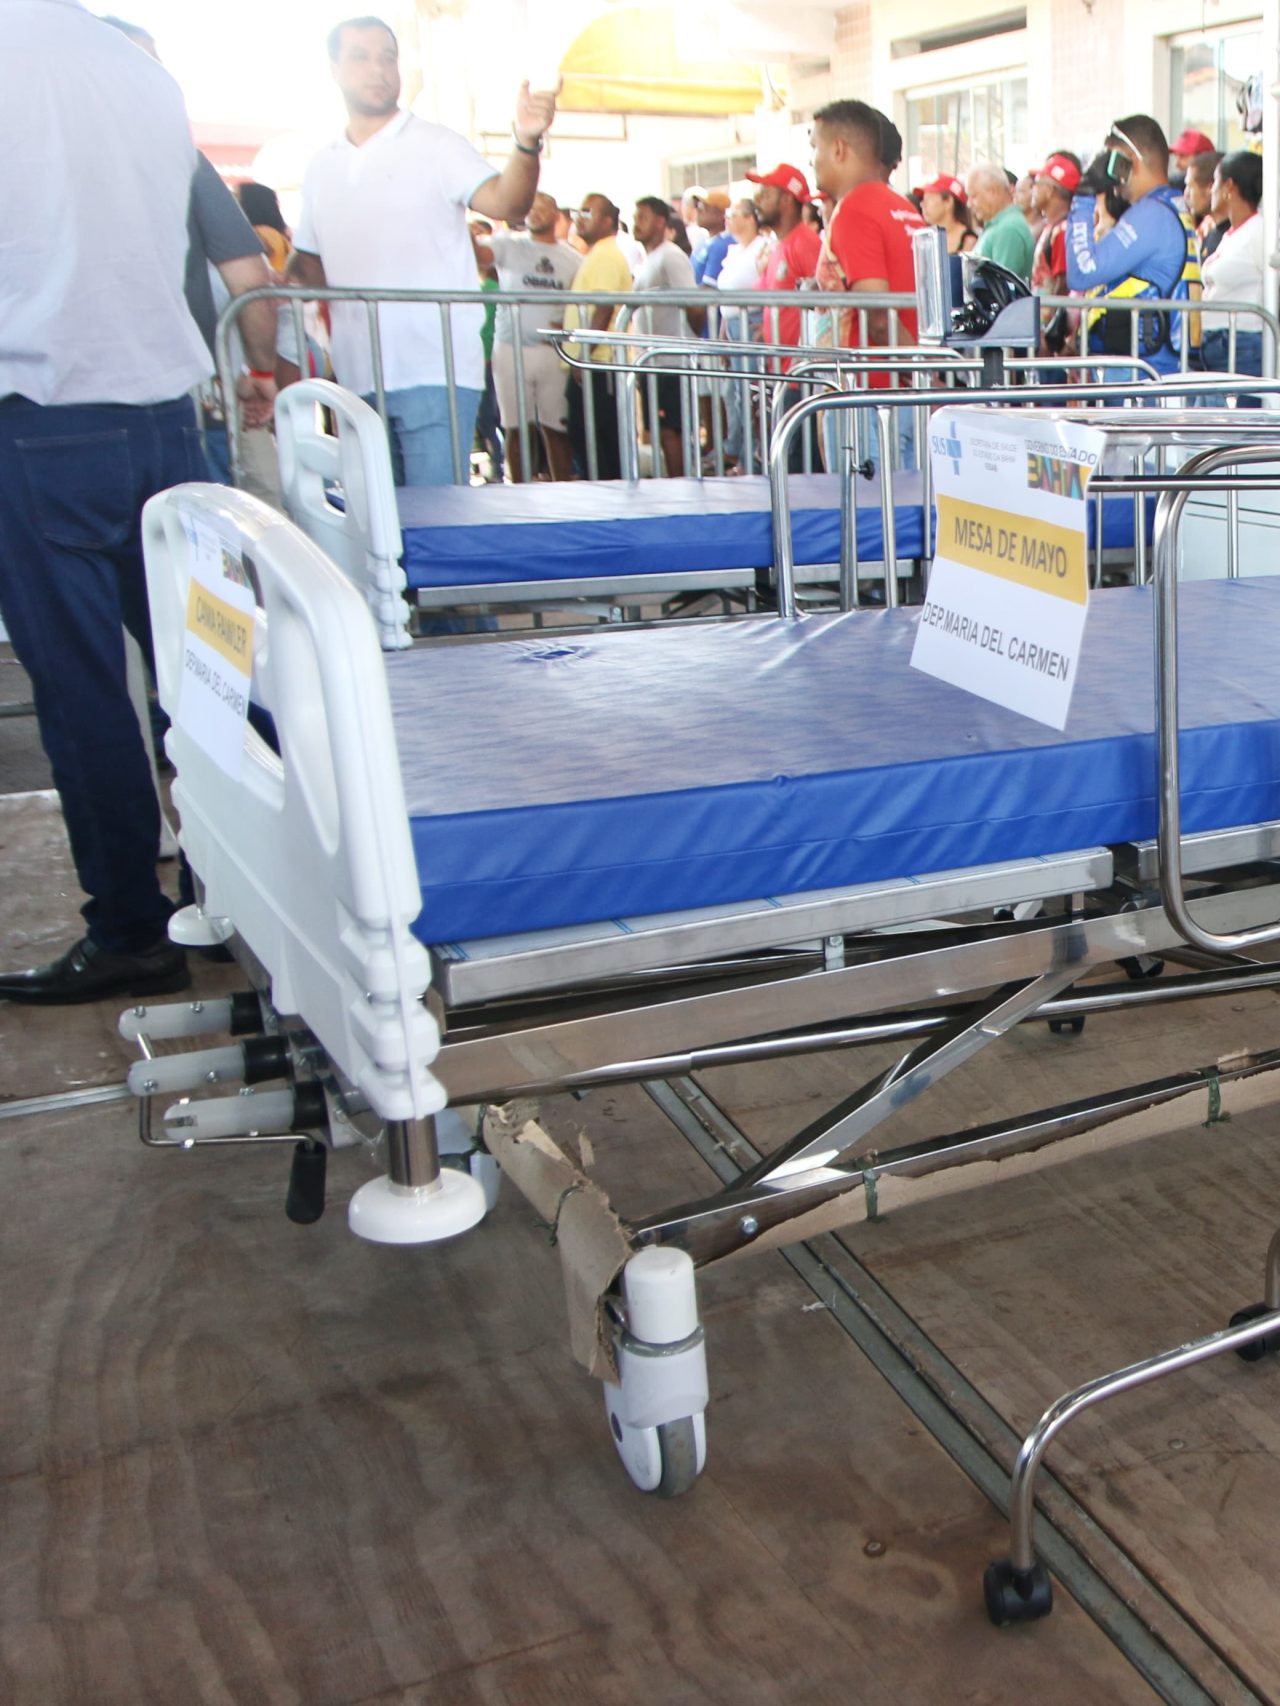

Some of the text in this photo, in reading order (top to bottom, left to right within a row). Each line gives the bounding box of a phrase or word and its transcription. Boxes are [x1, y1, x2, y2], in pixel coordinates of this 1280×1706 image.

[954, 517, 1068, 579] MESA DE MAYO
[923, 601, 1070, 682] DEP.MARIA DEL CARMEN
